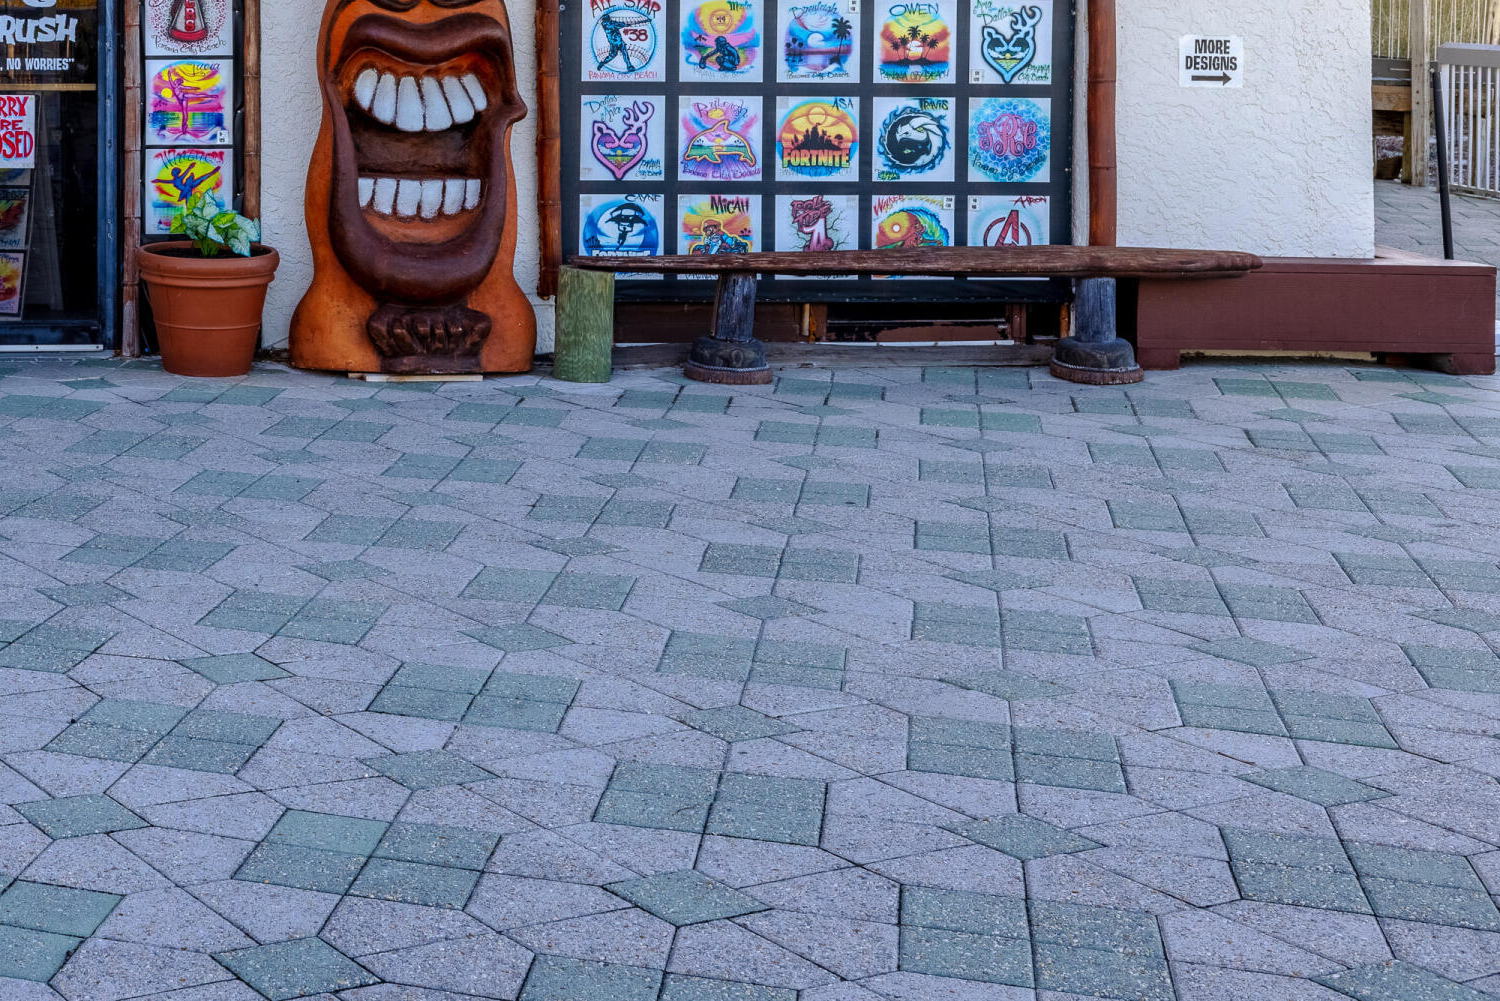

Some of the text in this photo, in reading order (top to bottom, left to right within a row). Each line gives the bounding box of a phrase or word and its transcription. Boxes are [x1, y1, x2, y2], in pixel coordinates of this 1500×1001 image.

[889, 2, 939, 16] OWEN
[623, 28, 648, 42] #38
[1195, 39, 1231, 54] MORE
[6, 58, 21, 70] NO
[1185, 55, 1238, 71] DESIGNS
[588, 71, 615, 80] PANAMA
[634, 72, 658, 80] BEACH
[832, 97, 853, 111] ASA
[782, 148, 850, 168] FORTNITE
